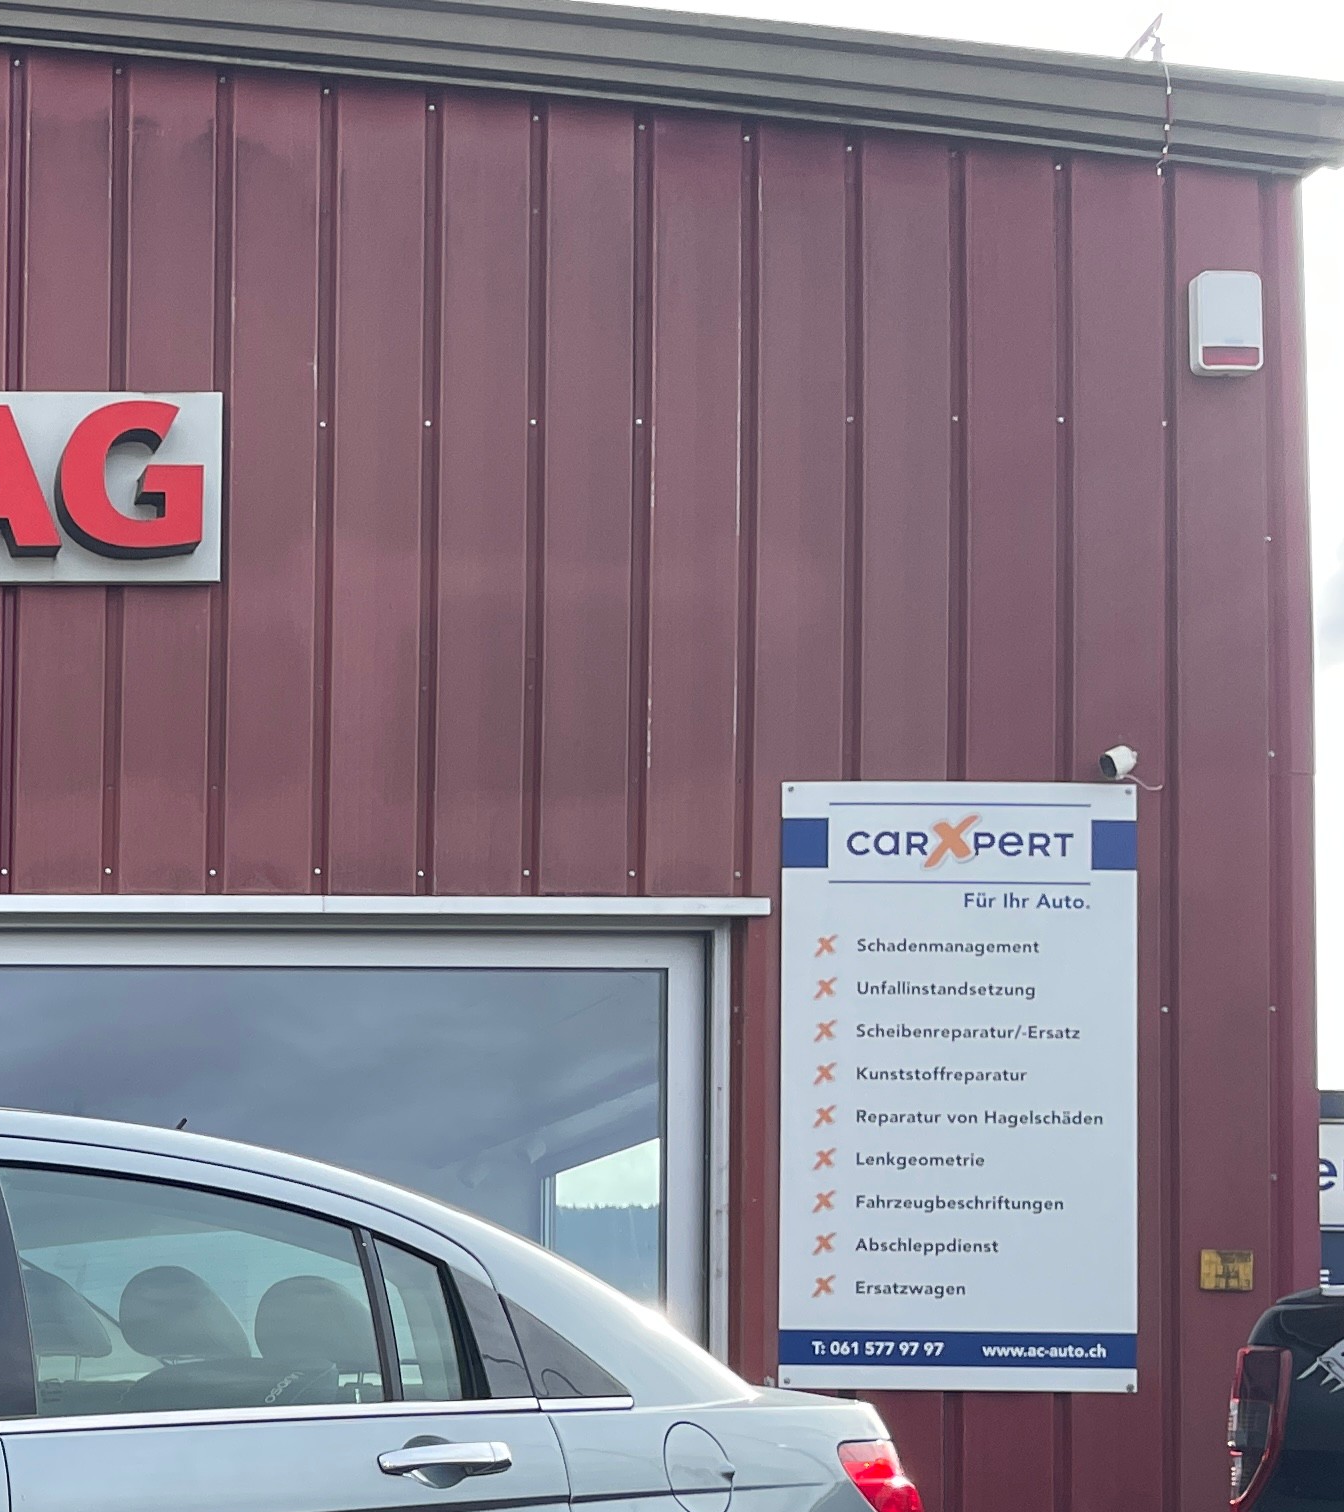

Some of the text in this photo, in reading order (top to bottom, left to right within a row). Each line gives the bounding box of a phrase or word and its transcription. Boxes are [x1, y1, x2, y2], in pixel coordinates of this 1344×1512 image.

[964, 892, 1092, 910] Für Ihr Auto.
[857, 937, 1040, 957] Schadenmanagement
[857, 980, 1036, 1001] Unfallinstandsetzung
[856, 1023, 1081, 1042] Scheibenreparatur/-Ersatz
[856, 1066, 1028, 1085] Kunststoffreparatur
[856, 1109, 1103, 1129] Reparatur von Hagelschäden
[856, 1151, 985, 1170] Lenkgeometrie
[855, 1194, 1065, 1215] Fahrzeugbeschriftungen
[855, 1237, 1000, 1257] Abschleppdienst
[855, 1280, 966, 1299] Ersatzwagen
[812, 1340, 1107, 1359] T: 061 577 97 97 www.ac-auto.ch
